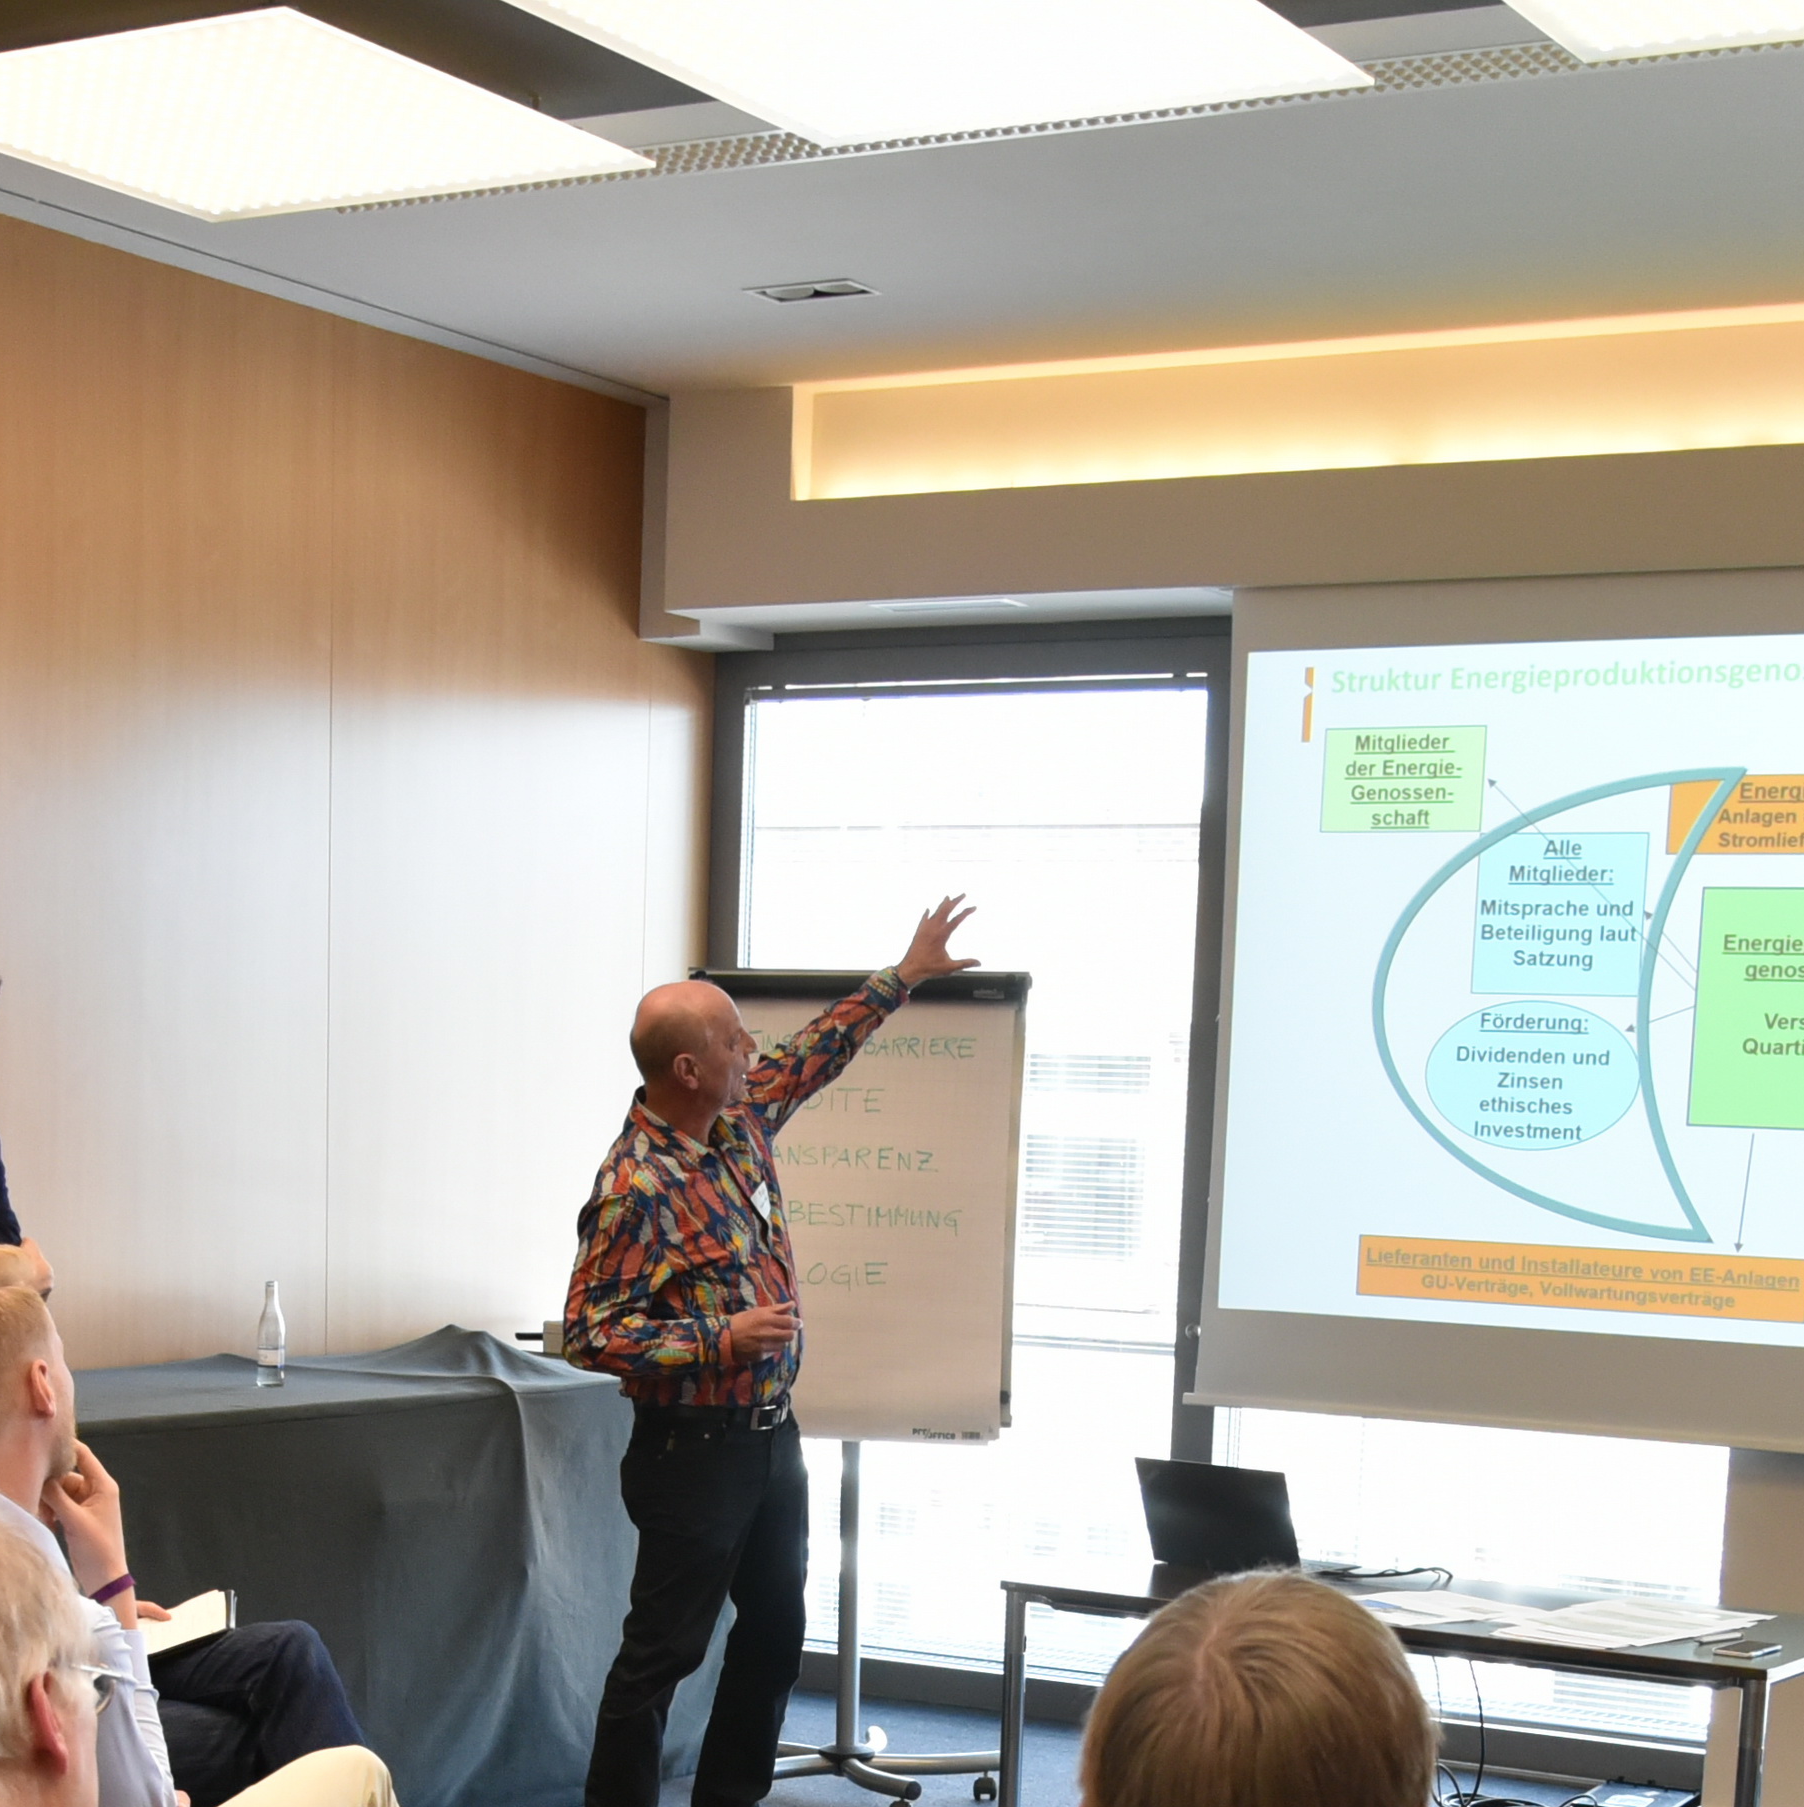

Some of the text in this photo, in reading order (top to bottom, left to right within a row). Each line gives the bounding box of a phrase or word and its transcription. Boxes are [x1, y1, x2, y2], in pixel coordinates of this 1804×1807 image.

[1331, 668, 1441, 694] Struktur
[1355, 733, 1450, 754] Mitglieder
[1345, 758, 1462, 780] der Energie-
[1351, 784, 1454, 802] Genossen-
[1372, 809, 1430, 827] schaft
[1718, 809, 1797, 827] Anlagen
[1543, 840, 1582, 857] Alle
[1509, 865, 1614, 885] Mitglieder:
[1480, 900, 1634, 921] Mitsprache und
[1480, 924, 1637, 945] Beteiligung laut
[1513, 950, 1593, 971] Satzung
[1480, 1012, 1589, 1033] Förderung:
[1456, 1046, 1610, 1066] Dividenden und
[1497, 1072, 1563, 1090] Zinsen
[804, 1087, 885, 1113] DITE
[1479, 1097, 1573, 1115] ethisches
[1474, 1121, 1582, 1141] Investment
[773, 1145, 938, 1173] ANSPARENZ
[787, 1199, 963, 1237] BESTIMMUNG
[1366, 1247, 1800, 1290] Lieferanten und Installateure von EE-Anlagen
[1421, 1273, 1735, 1310] GU-Verträge, Vollwartungsverträge
